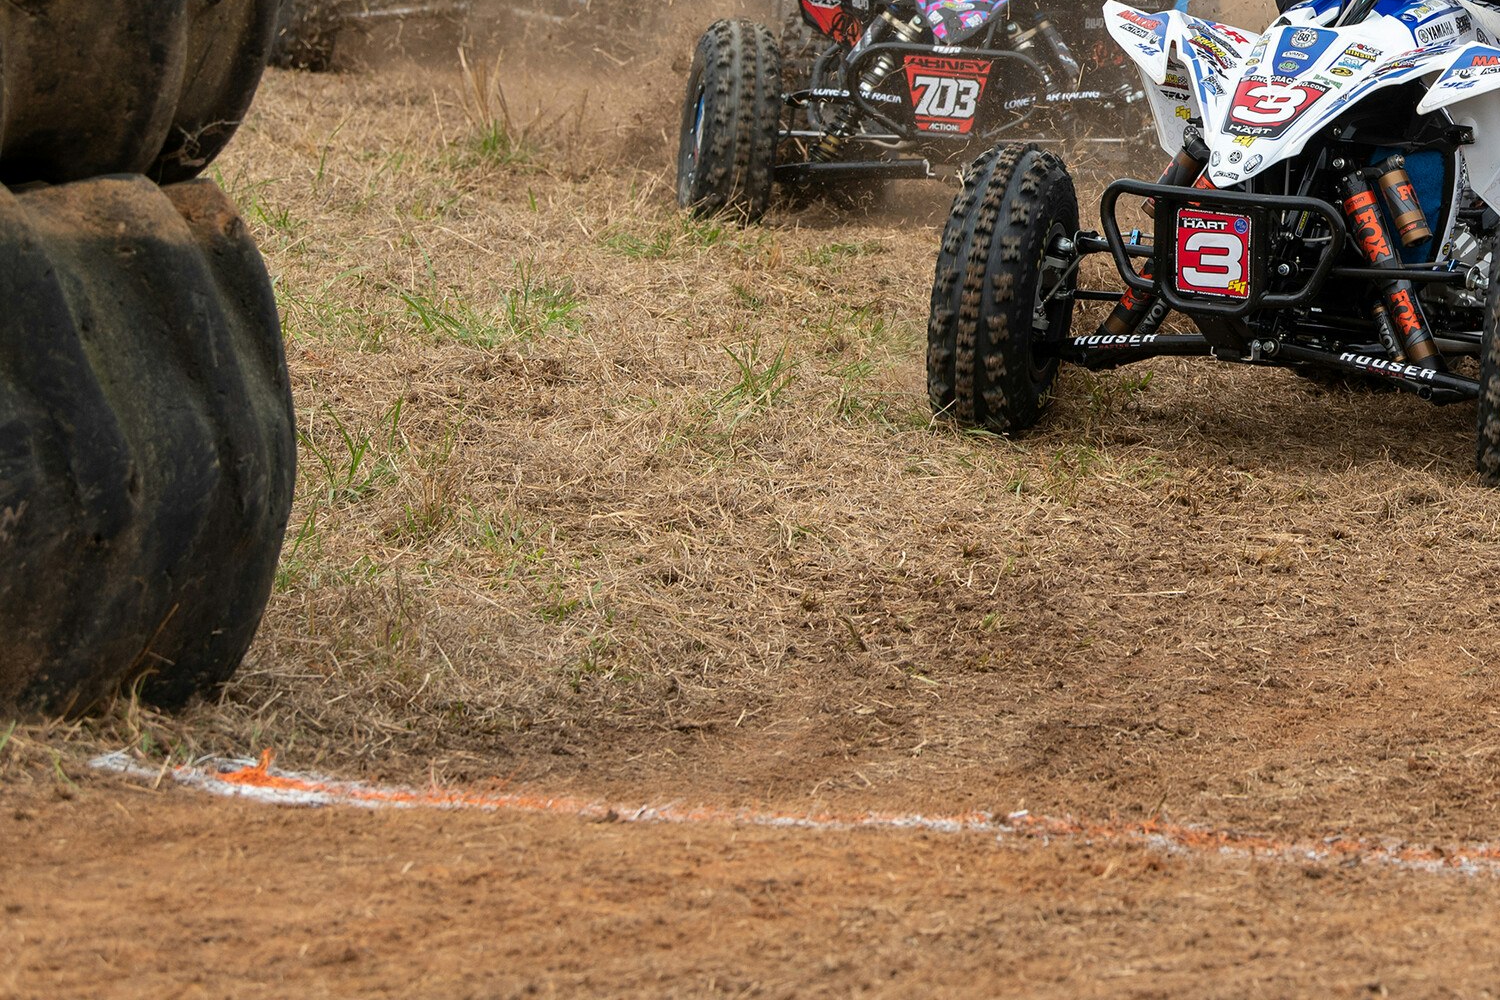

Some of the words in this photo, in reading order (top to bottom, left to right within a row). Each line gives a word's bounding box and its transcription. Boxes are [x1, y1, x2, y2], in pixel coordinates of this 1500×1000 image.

[1426, 21, 1455, 41] YAMAHA
[914, 75, 980, 118] 703
[1232, 85, 1308, 123] 3
[1228, 124, 1273, 135] HART
[1396, 183, 1419, 204] FO
[1183, 219, 1229, 231] HART
[1355, 207, 1391, 263] FOX
[1181, 231, 1244, 289] 3
[1390, 288, 1422, 336] FOX
[1074, 333, 1159, 346] HOUSER
[1339, 351, 1437, 381] HOUSER
